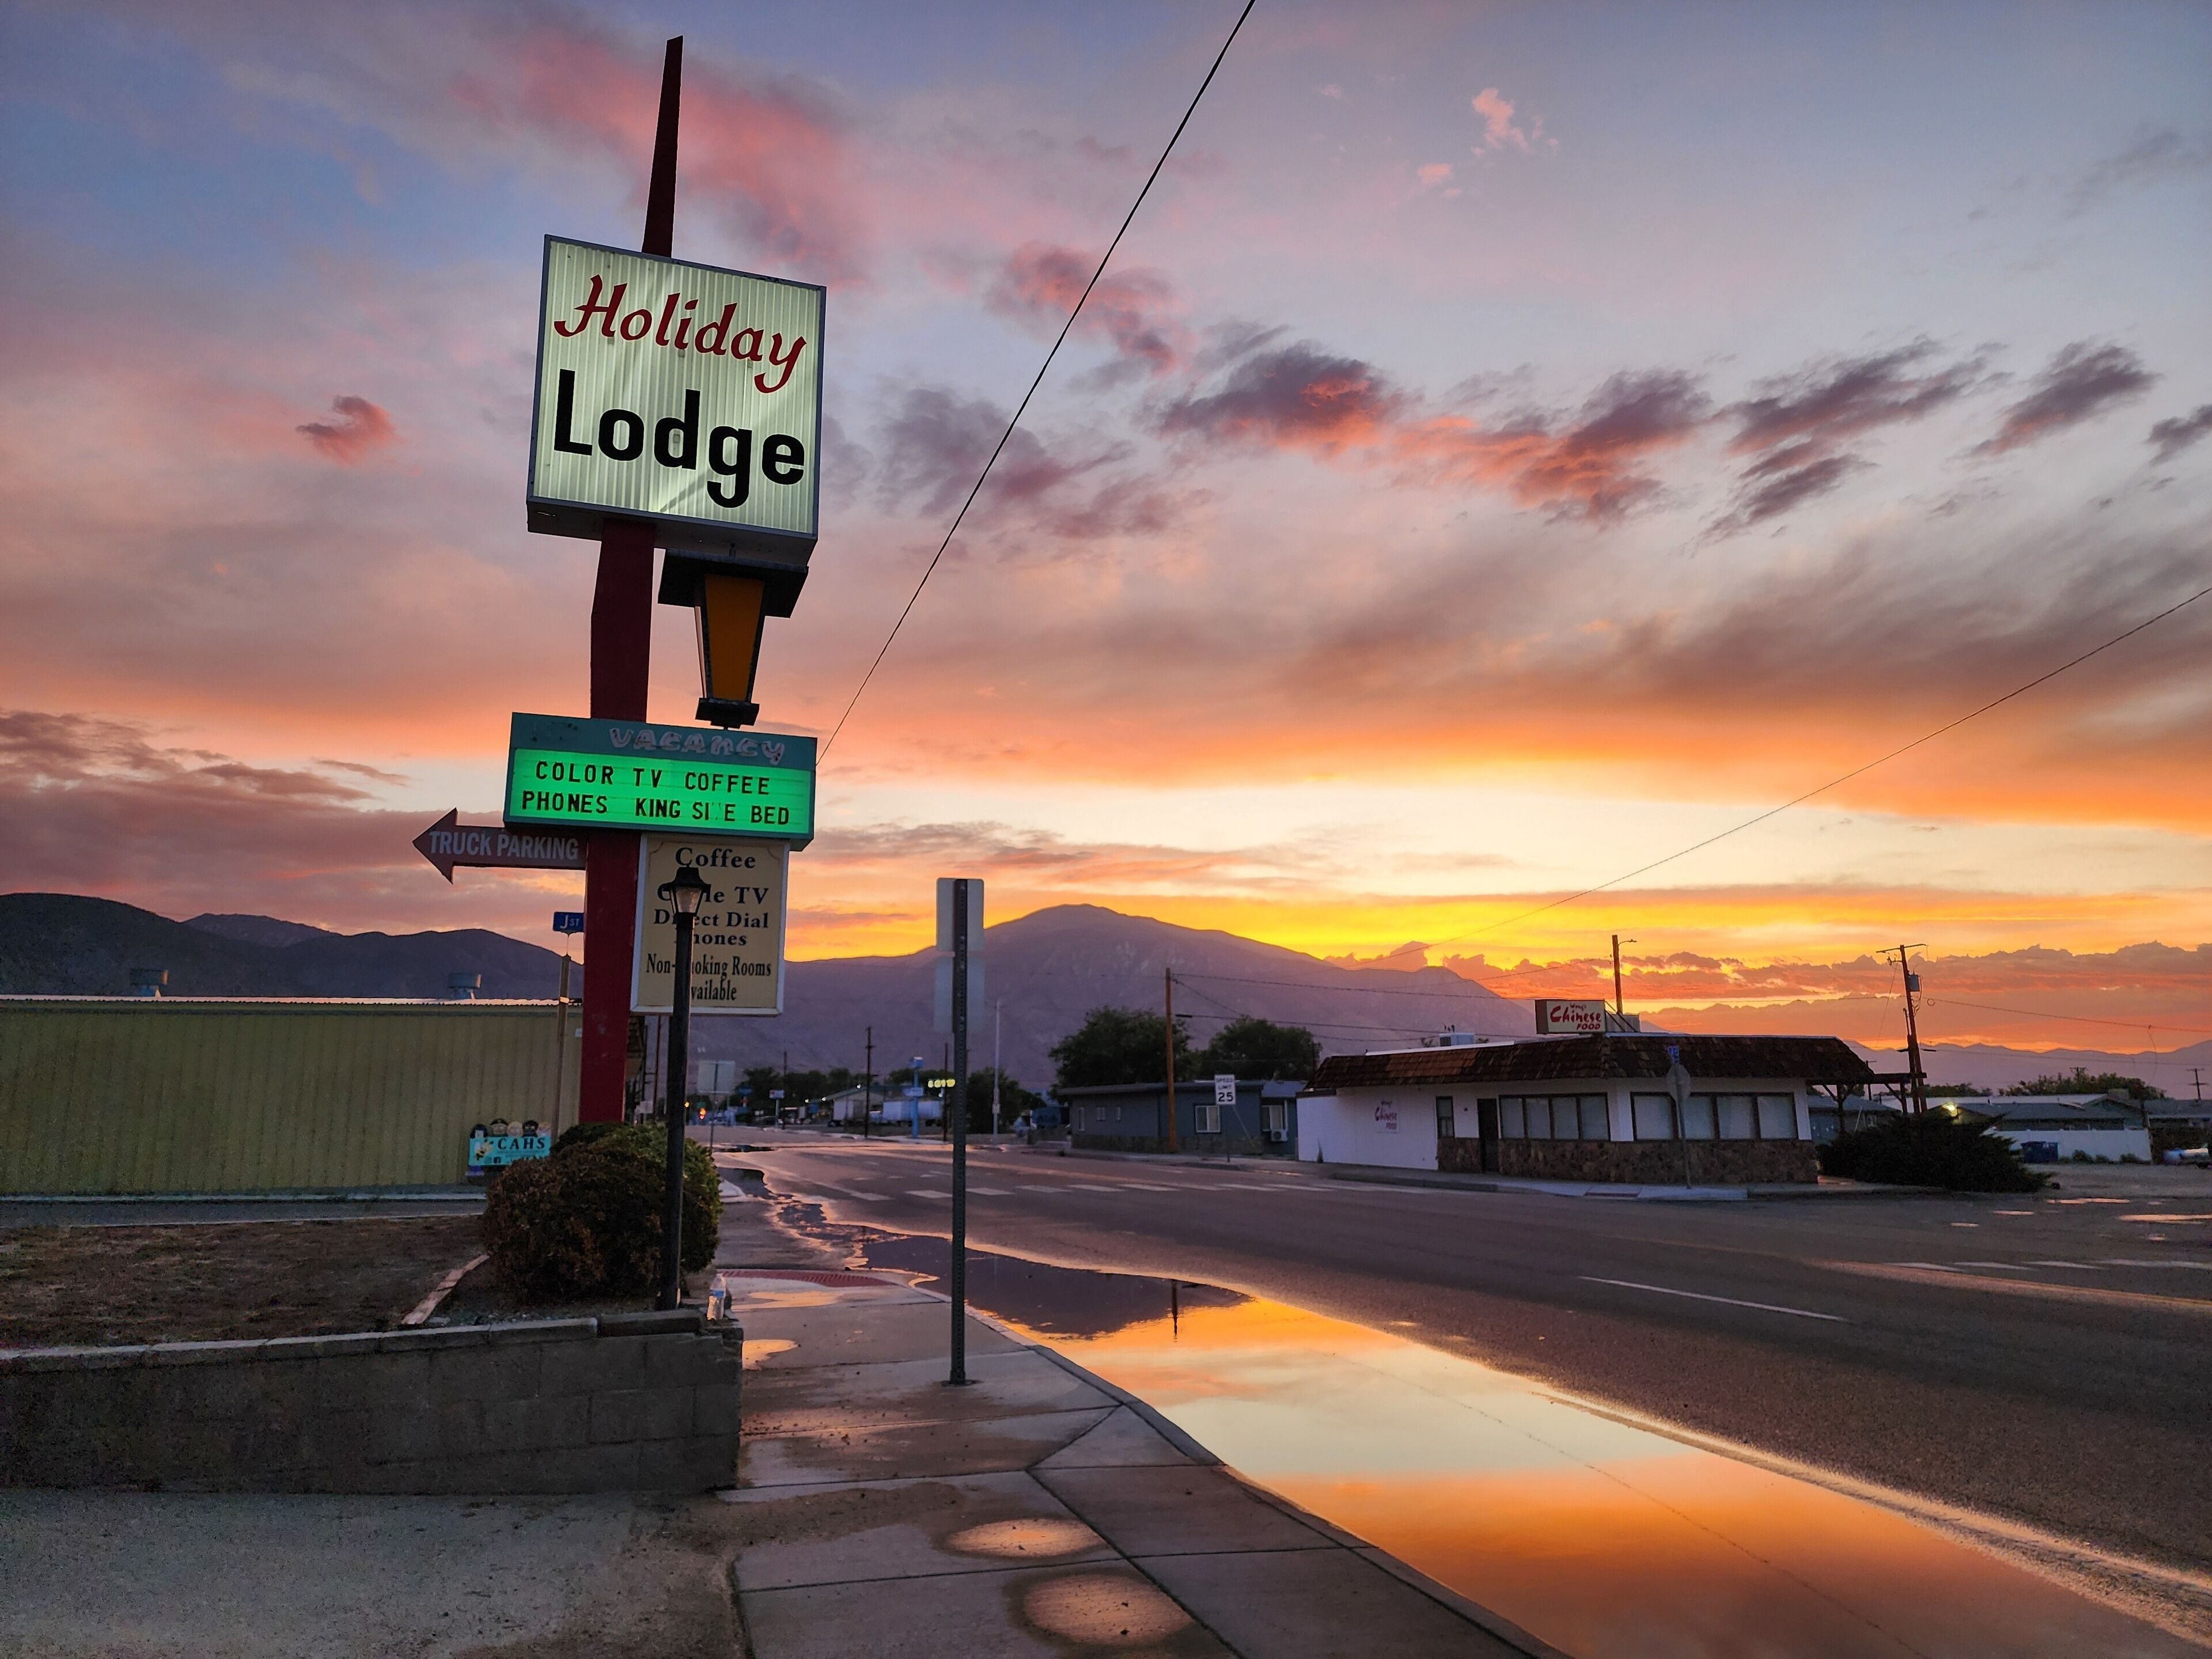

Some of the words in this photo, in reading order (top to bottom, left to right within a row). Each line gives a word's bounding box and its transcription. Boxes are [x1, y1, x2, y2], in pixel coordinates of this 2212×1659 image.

[554, 274, 806, 393] Holiday
[554, 369, 805, 508] Lodge
[536, 761, 613, 785] COLOR
[633, 768, 662, 788] TV
[684, 772, 770, 795] COFFEE
[522, 790, 608, 813] PHONES
[635, 798, 681, 819] KING
[692, 801, 736, 821] SIE
[751, 805, 789, 825] BED
[429, 831, 491, 857] TRUCK
[497, 834, 578, 860] PARKING
[675, 847, 756, 868] Coffee
[657, 884, 725, 903] Cle
[735, 887, 768, 904] TV
[560, 915, 569, 929] J
[727, 912, 768, 928] Dial
[732, 956, 771, 976] Rooms
[690, 980, 737, 1001] vailable
[1550, 1005, 1601, 1023] Chinese
[1218, 1092, 1233, 1102] 25
[498, 1137, 545, 1150] CAHS
